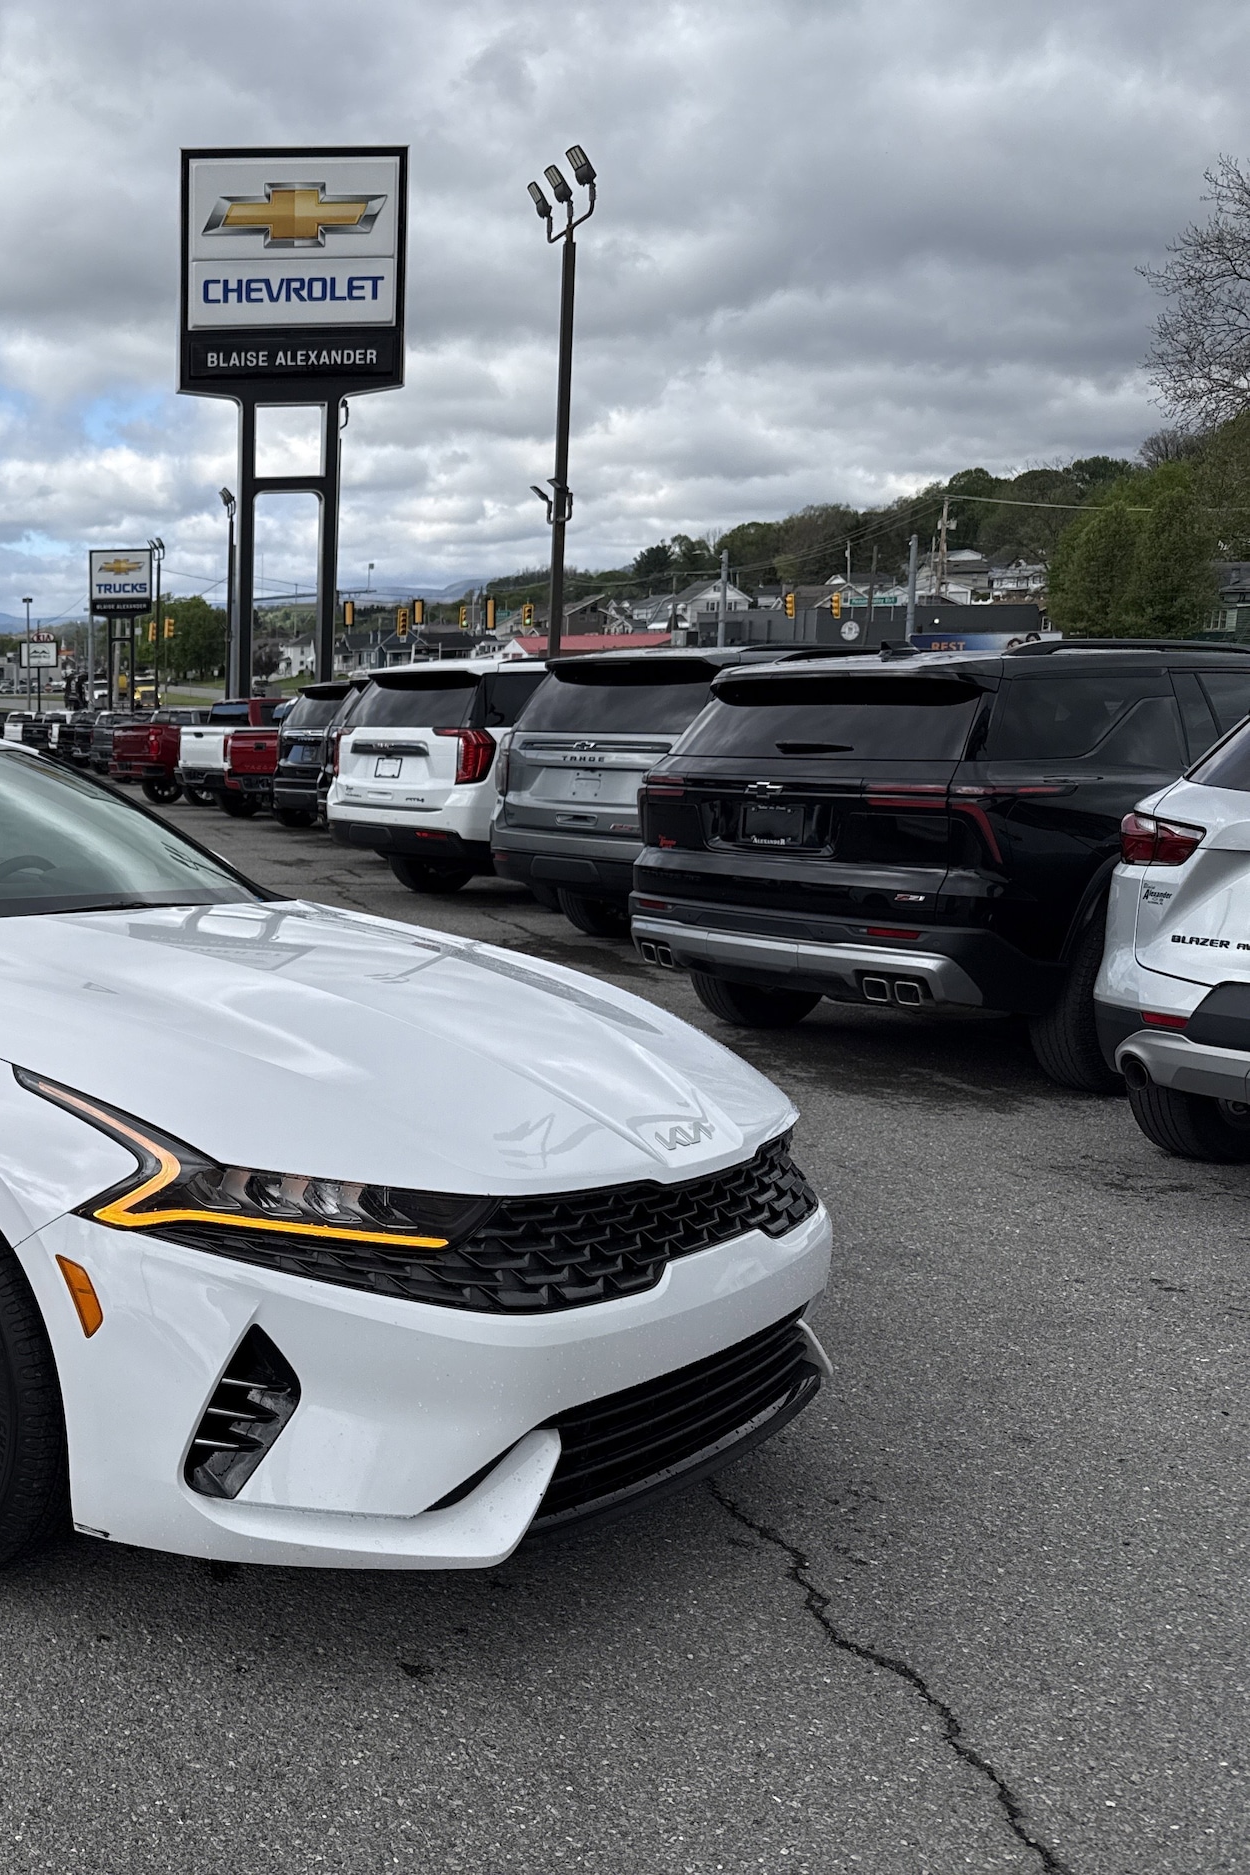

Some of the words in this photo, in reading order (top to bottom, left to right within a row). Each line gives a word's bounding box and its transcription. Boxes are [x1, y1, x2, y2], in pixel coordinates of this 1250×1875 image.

[203, 276, 385, 304] CHEVROLET
[207, 351, 268, 367] BLAISE
[275, 349, 377, 366] ALEXANDER
[96, 583, 147, 594] TRUCKS
[36, 634, 51, 642] KIA
[562, 755, 605, 763] TAHOE
[1143, 889, 1172, 899] Alexander
[1171, 934, 1231, 949] BLAZER
